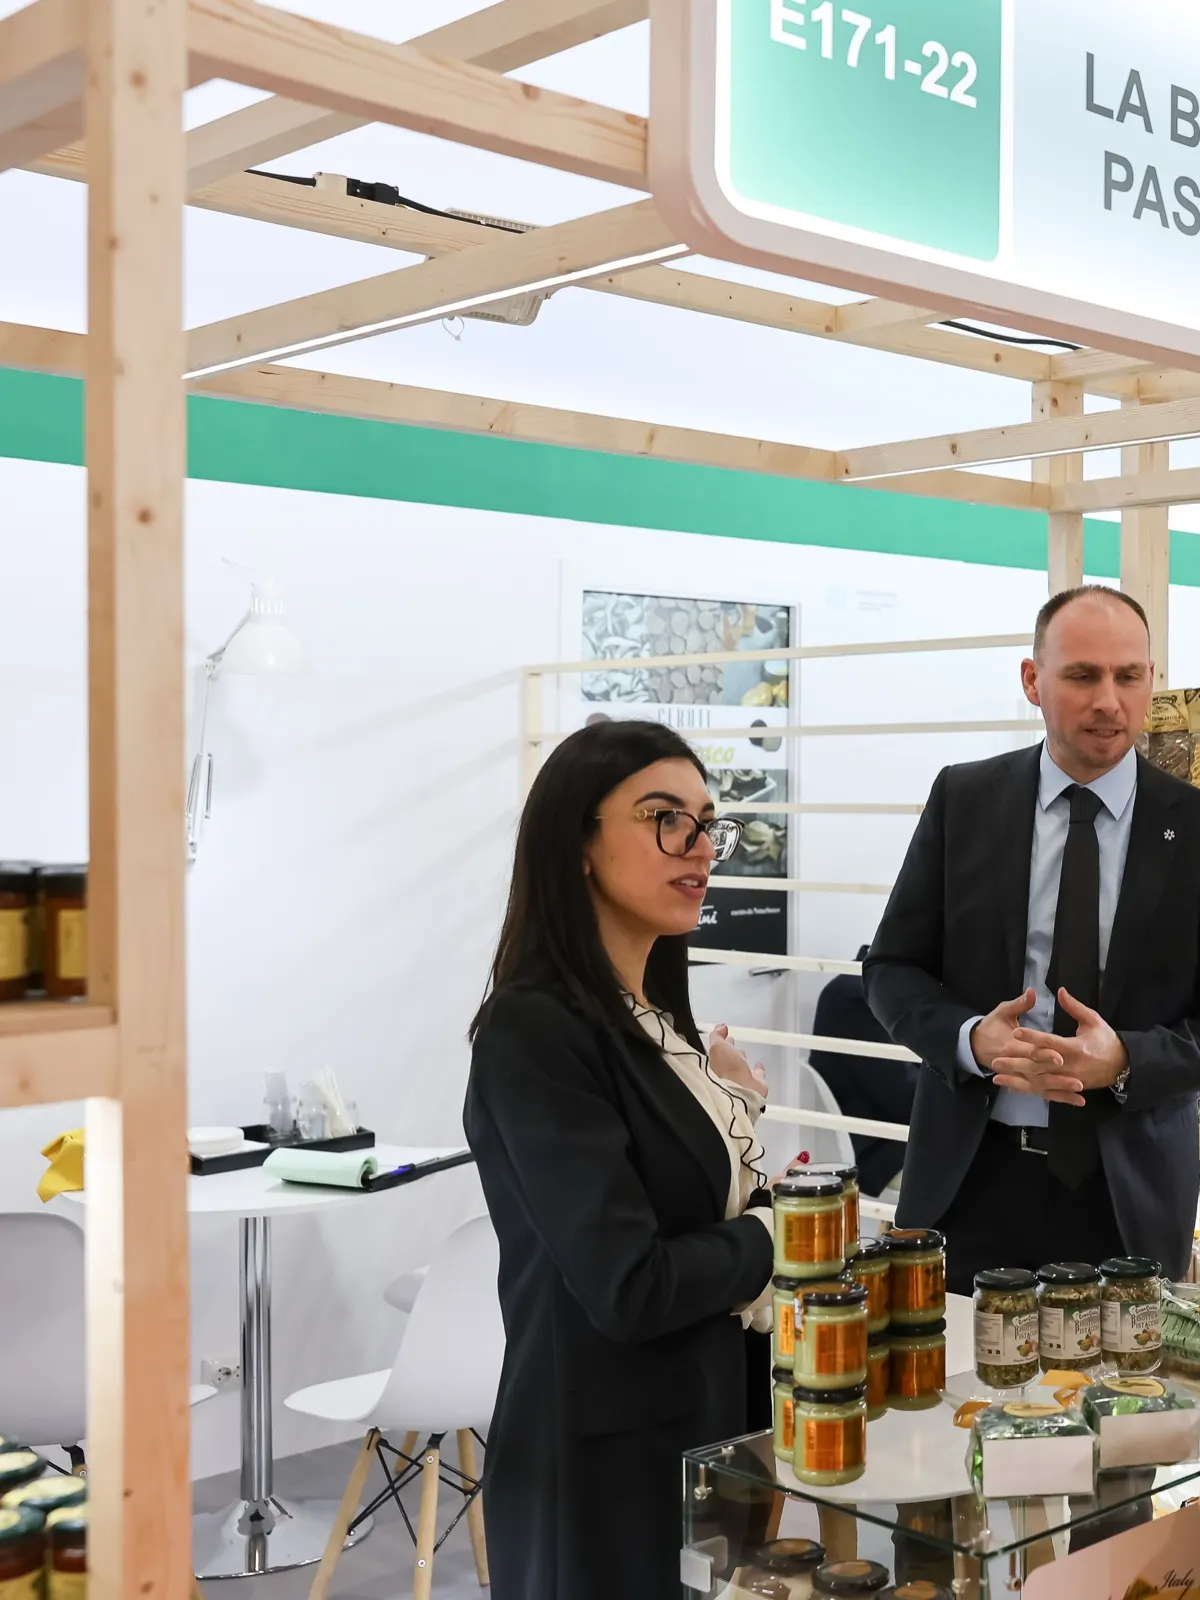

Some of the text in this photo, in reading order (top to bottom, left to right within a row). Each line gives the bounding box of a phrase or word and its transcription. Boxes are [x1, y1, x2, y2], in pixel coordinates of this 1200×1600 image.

[770, 0, 977, 108] E171-22
[1085, 51, 1154, 134] LA
[1160, 1567, 1195, 1600] Italy
